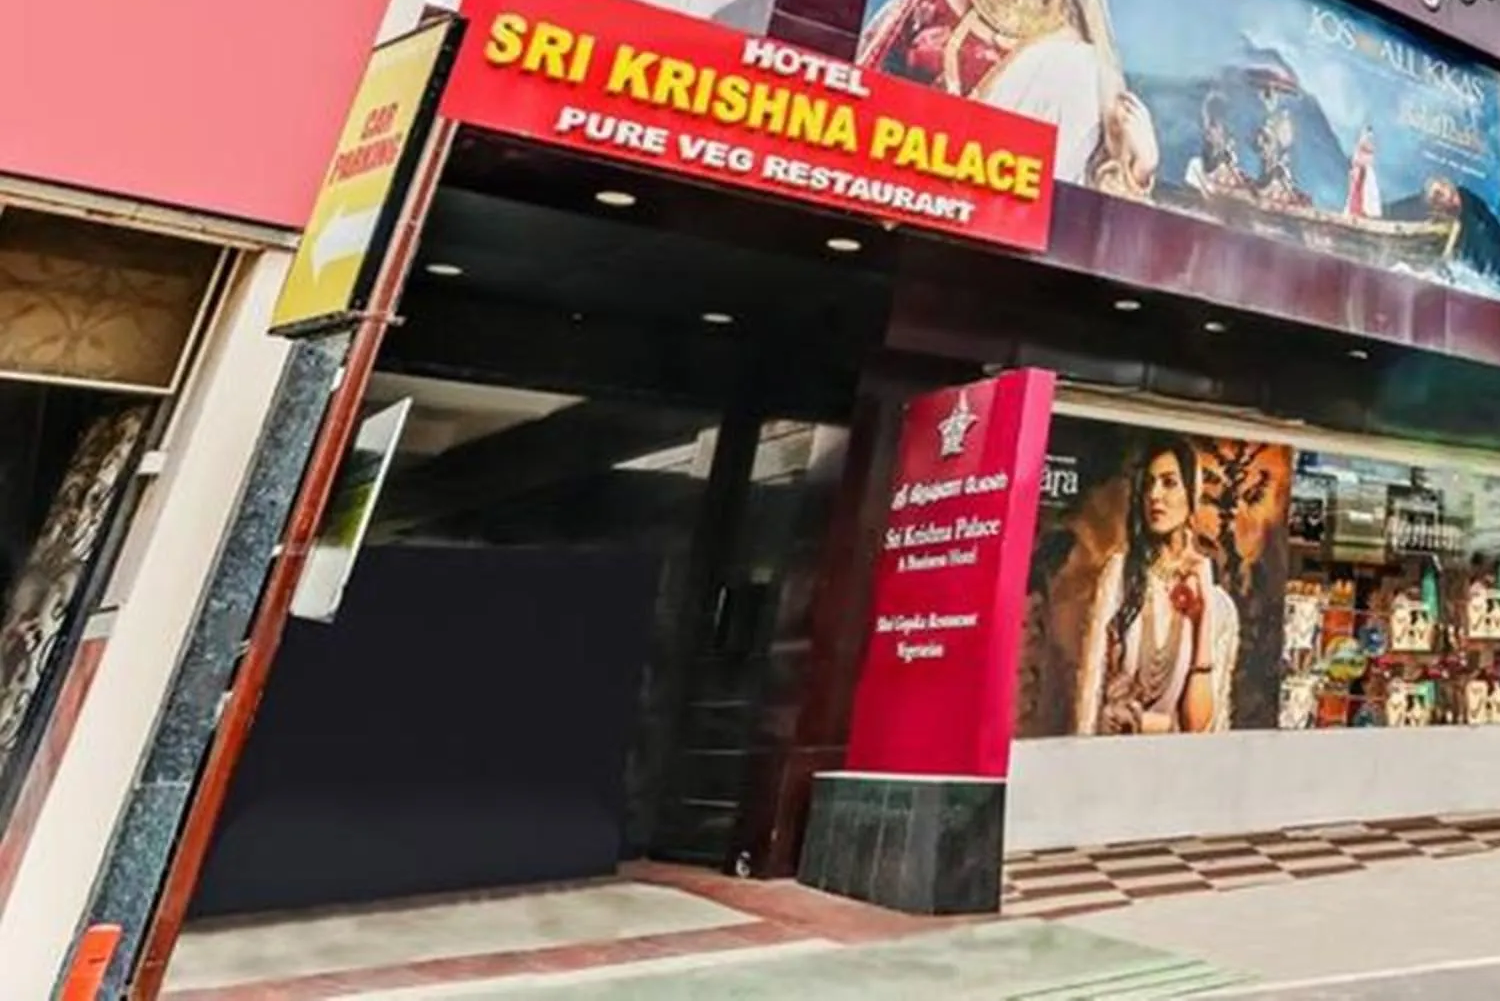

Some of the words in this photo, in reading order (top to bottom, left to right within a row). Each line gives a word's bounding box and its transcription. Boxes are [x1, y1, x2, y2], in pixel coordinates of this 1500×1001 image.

[484, 11, 596, 84] SRI
[605, 44, 858, 152] KRISHNA
[870, 115, 1043, 201] PALACE
[742, 39, 871, 97] HOTEL
[556, 106, 670, 156] PURE
[678, 134, 754, 173] VEG
[762, 155, 977, 223] RESTAURANT
